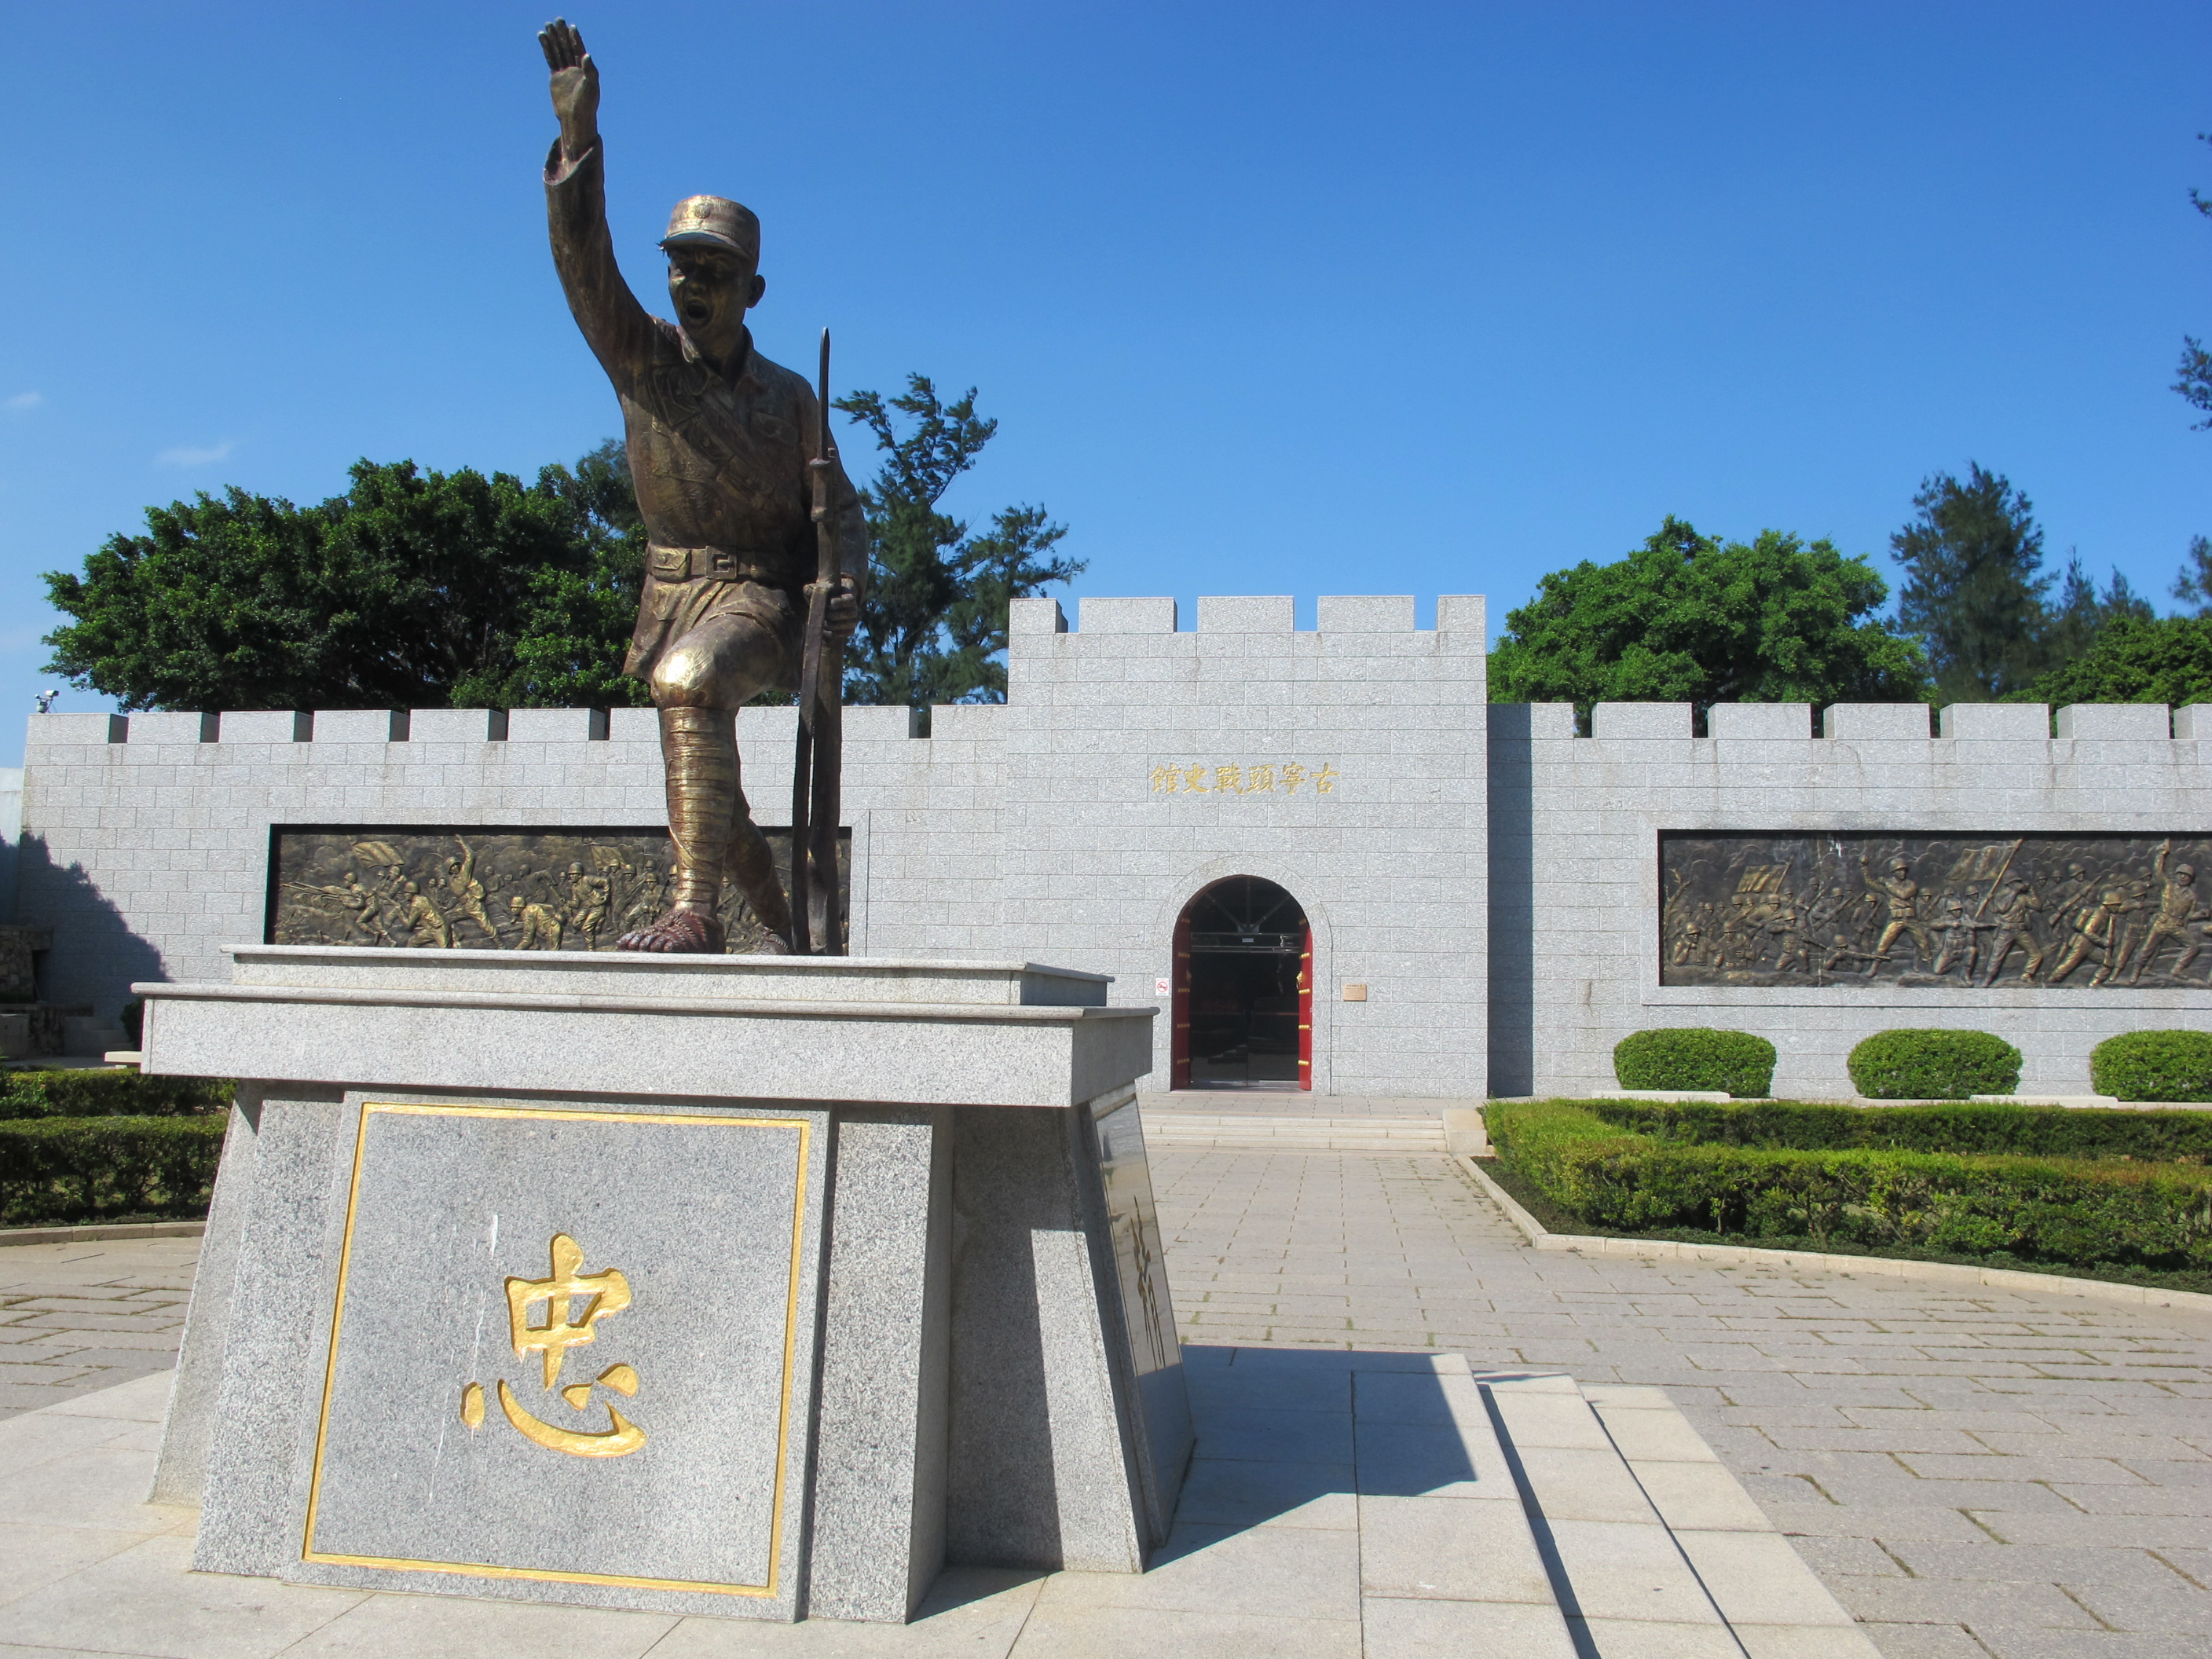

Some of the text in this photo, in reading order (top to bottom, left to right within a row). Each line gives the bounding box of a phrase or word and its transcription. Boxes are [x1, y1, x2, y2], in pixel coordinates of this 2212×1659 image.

[1149, 761, 1339, 796] 古寧頭戰史館
[460, 1232, 648, 1458] 忠
